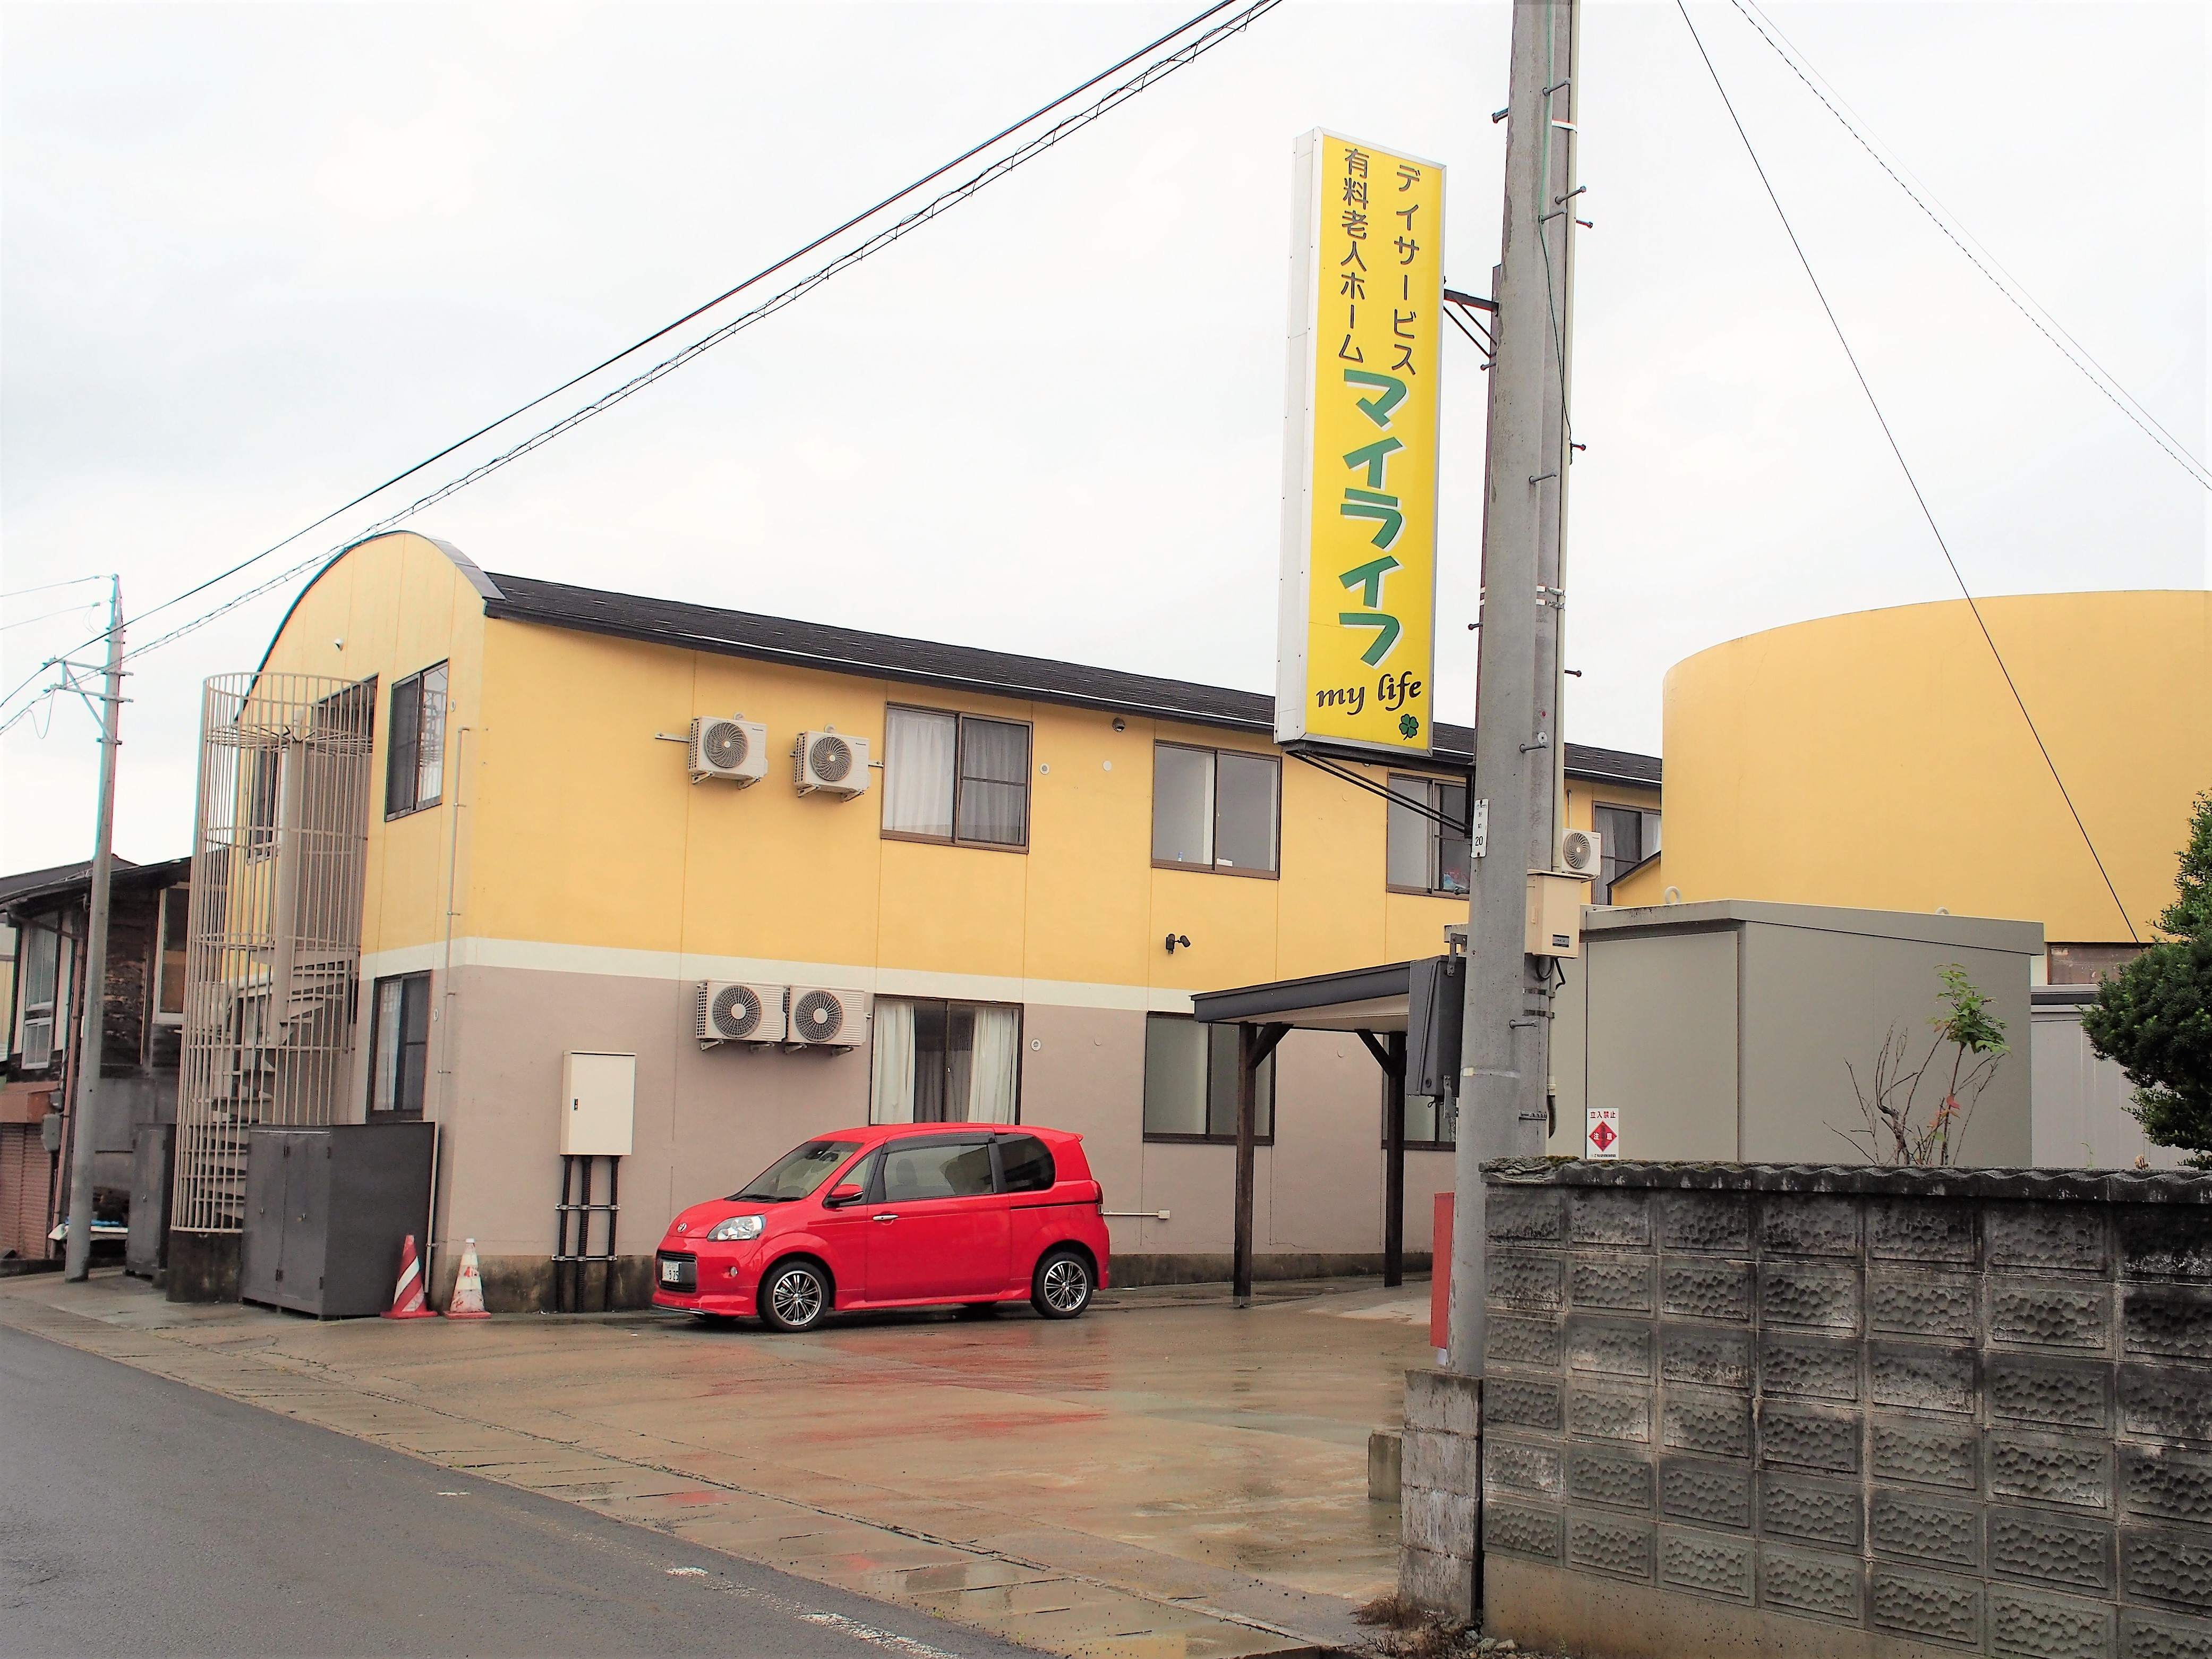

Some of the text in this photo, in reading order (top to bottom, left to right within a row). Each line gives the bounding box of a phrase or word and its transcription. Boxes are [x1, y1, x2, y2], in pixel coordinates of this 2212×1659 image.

[1338, 148, 1369, 364] 有料老人ホーム
[1338, 369, 1407, 669] マイライフ
[1316, 671, 1422, 716] my life
[1475, 836, 1483, 846] 20
